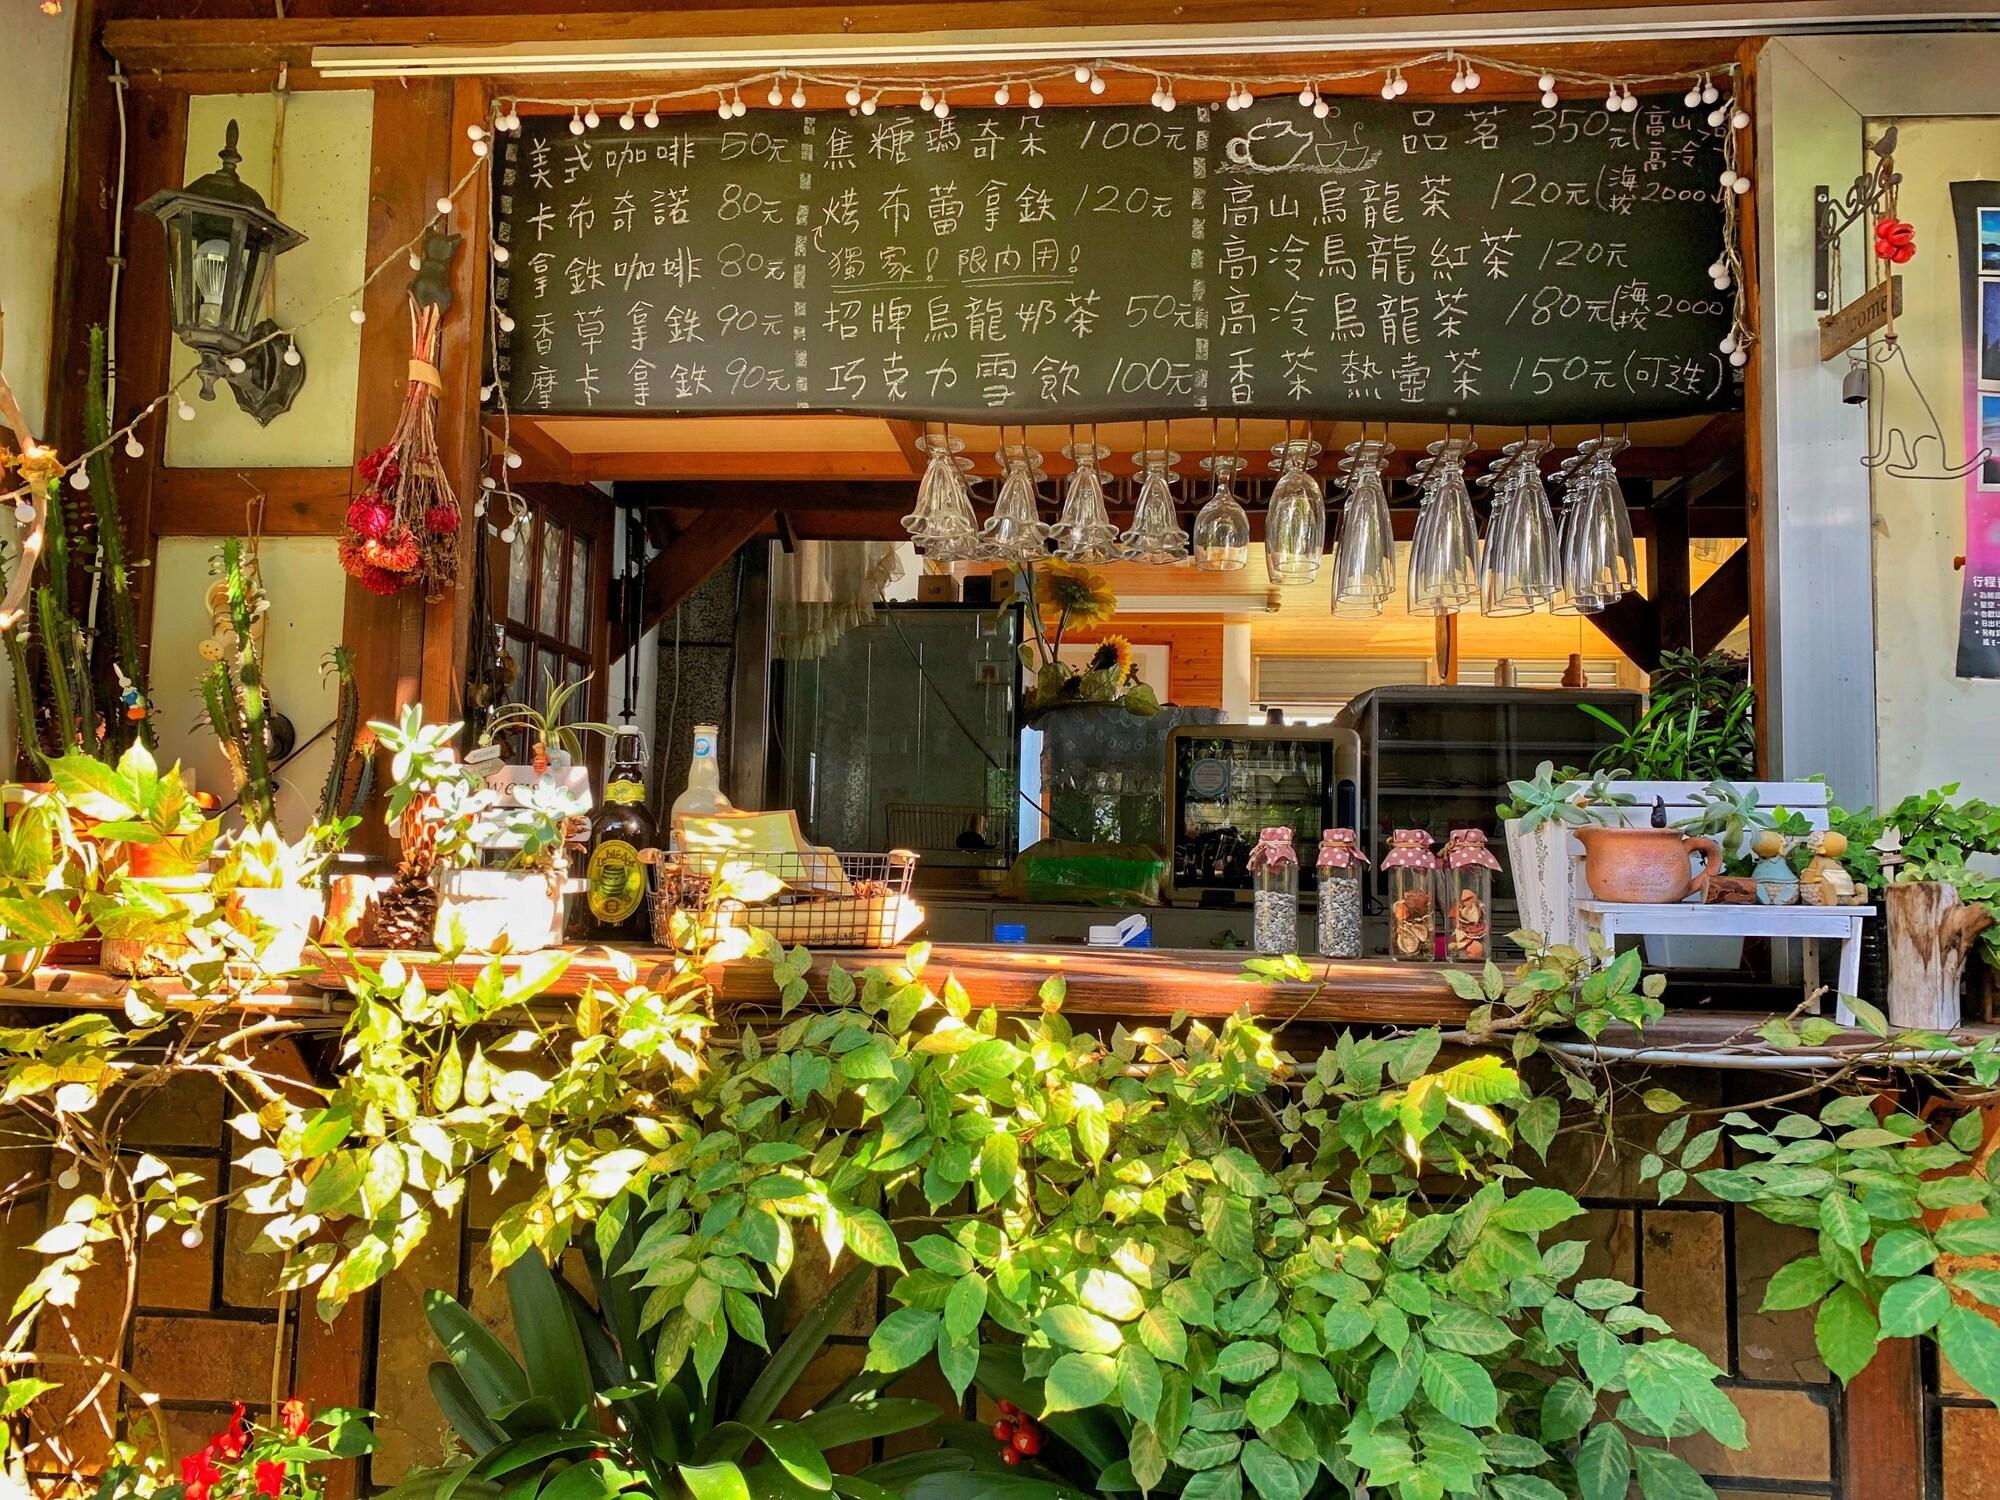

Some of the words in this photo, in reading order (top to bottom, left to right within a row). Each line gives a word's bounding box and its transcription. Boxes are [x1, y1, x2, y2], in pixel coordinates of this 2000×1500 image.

[824, 115, 1047, 170] 焦糖瑪奇朵
[1080, 120, 1187, 151] 100元
[1402, 106, 1507, 154] 品茗
[529, 132, 695, 188] 美式咖啡
[720, 132, 792, 162] 50元
[526, 186, 690, 241] 卡布奇諾
[717, 183, 783, 224] 80元
[1074, 185, 1173, 218] 120元
[1222, 174, 1452, 229] 高山烏龍茶
[717, 243, 785, 281] 80元
[1218, 227, 1522, 285] 高冷烏龍紅茶
[1538, 238, 1629, 271] 120元
[716, 304, 784, 337] 90元
[822, 289, 1100, 343] 招牌烏龍奶茶
[1126, 294, 1195, 329] 50元
[1219, 286, 1470, 346] 高冷烏龍茶
[726, 357, 791, 394] 90元
[825, 351, 1081, 407] 巧克力雪飲
[1106, 356, 1193, 396] 100元
[1972, 575, 2000, 588] 行程
